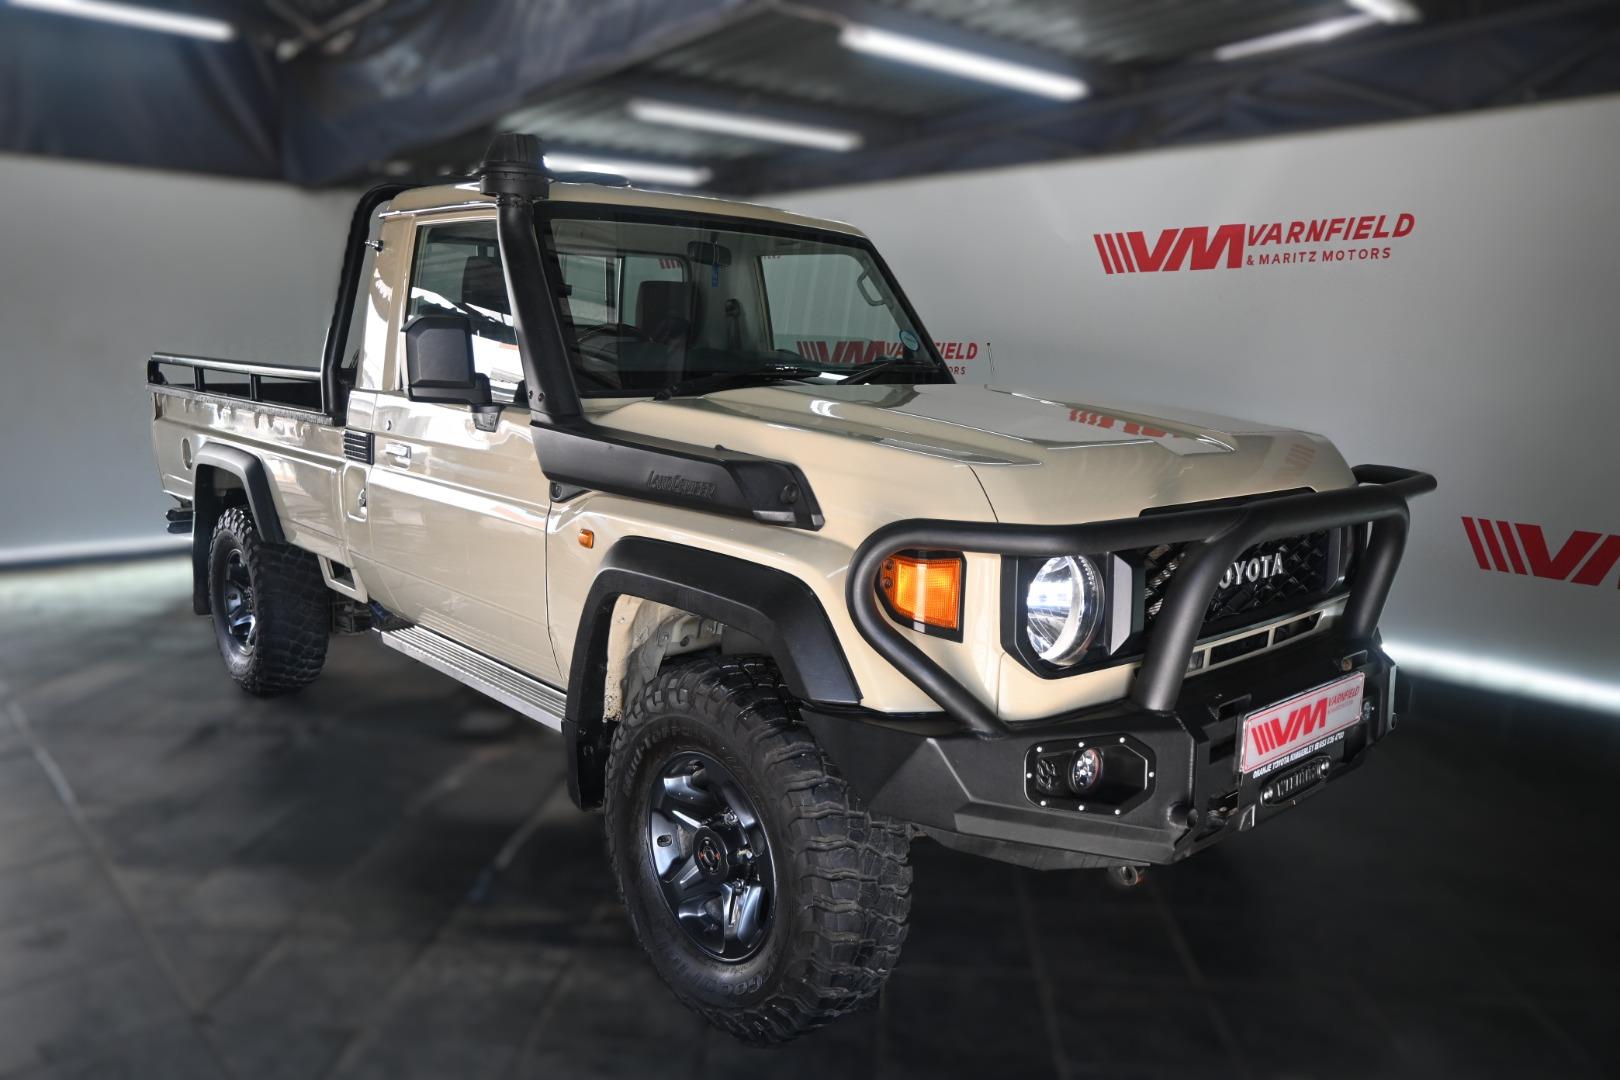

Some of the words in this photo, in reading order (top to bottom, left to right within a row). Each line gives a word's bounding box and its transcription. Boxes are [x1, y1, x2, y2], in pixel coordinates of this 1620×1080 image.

[1127, 223, 1247, 272] VM
[1247, 212, 1416, 247] VARNFIELD
[1246, 254, 1255, 266] &
[1259, 250, 1317, 265] MARITZ
[1322, 246, 1392, 262] MOTORS
[1270, 697, 1328, 748] VM
